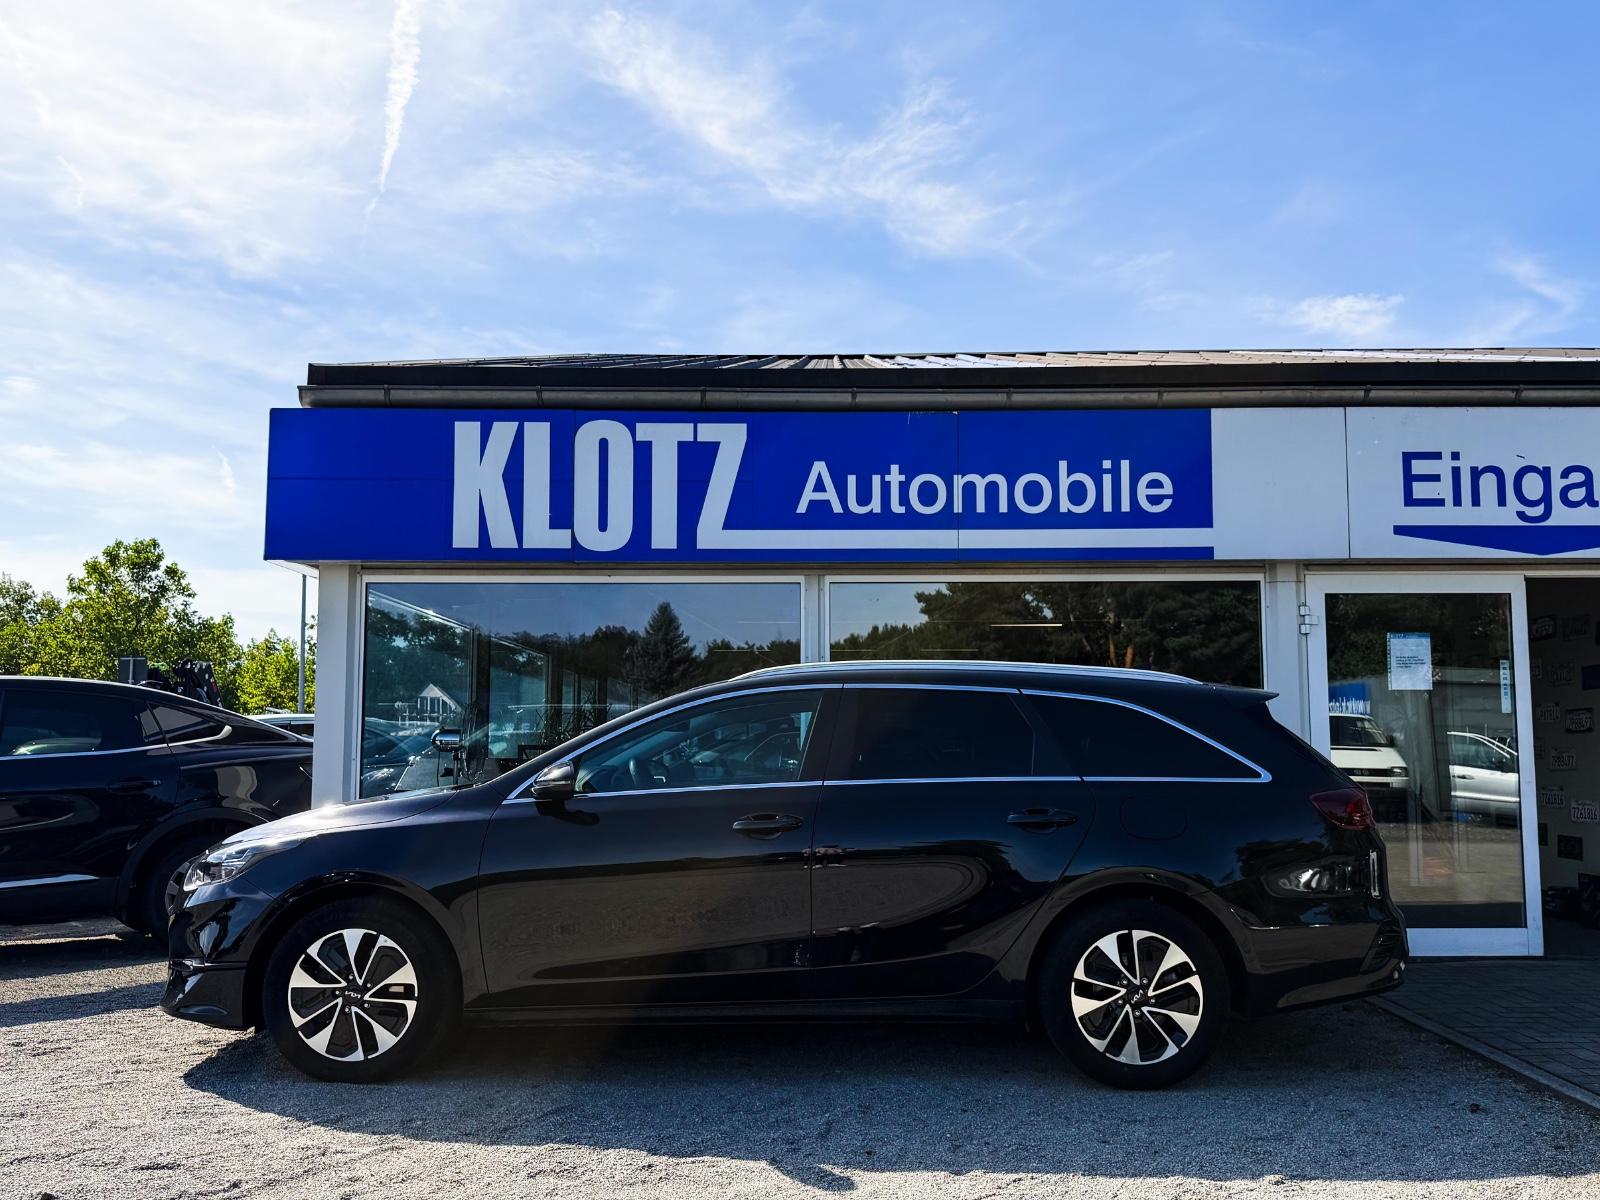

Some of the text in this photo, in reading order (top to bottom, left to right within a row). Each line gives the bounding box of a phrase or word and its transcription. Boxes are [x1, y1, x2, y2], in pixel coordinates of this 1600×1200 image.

[452, 419, 1174, 551] KLOTZ Automobile
[1401, 451, 1600, 524] Einga
[1572, 807, 1598, 820] 7Z61816
